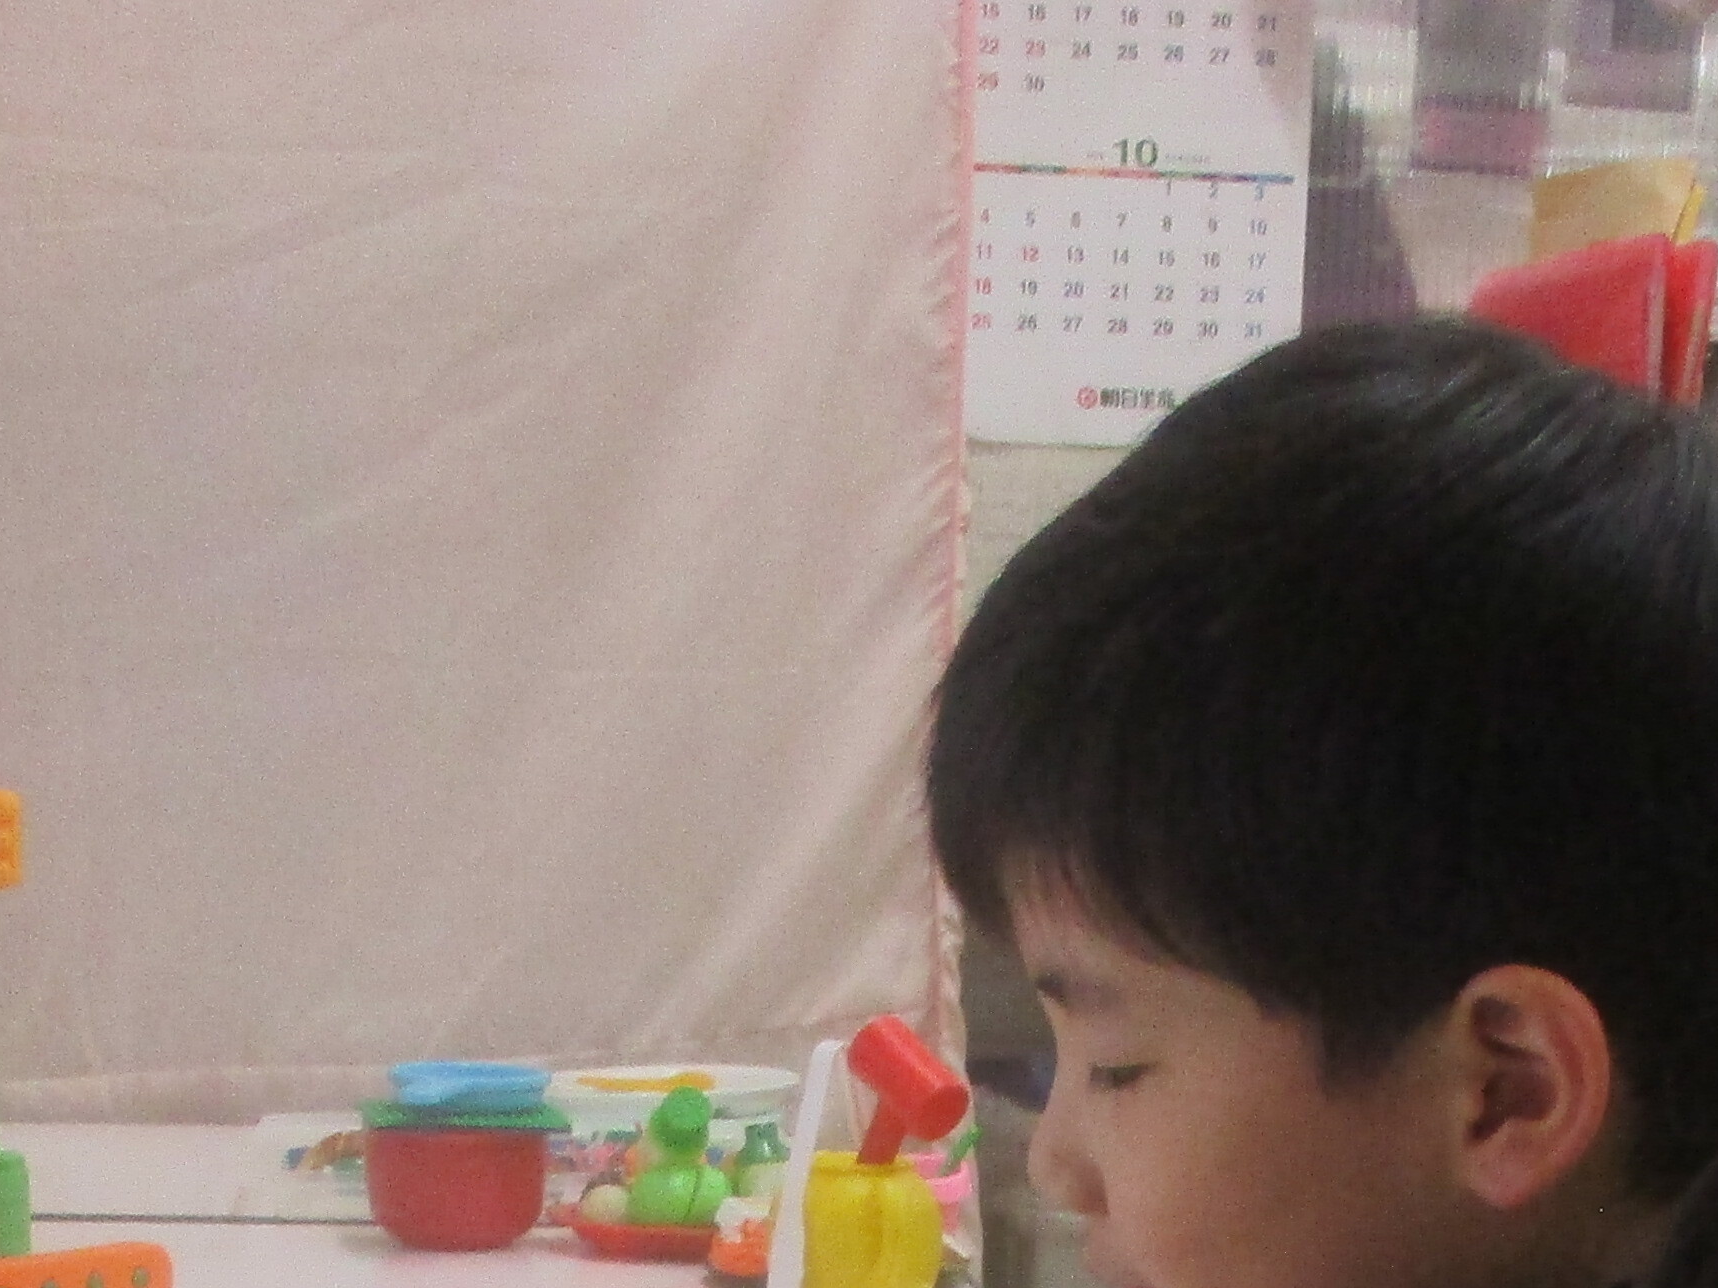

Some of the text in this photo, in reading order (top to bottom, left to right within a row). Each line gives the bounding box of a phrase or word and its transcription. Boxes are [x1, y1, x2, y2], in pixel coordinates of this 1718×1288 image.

[1113, 137, 1159, 167] 10
[976, 277, 1266, 303] 18 19 20 21 22 23 24
[973, 313, 1262, 338] 25 26 27 28 29 30 31
